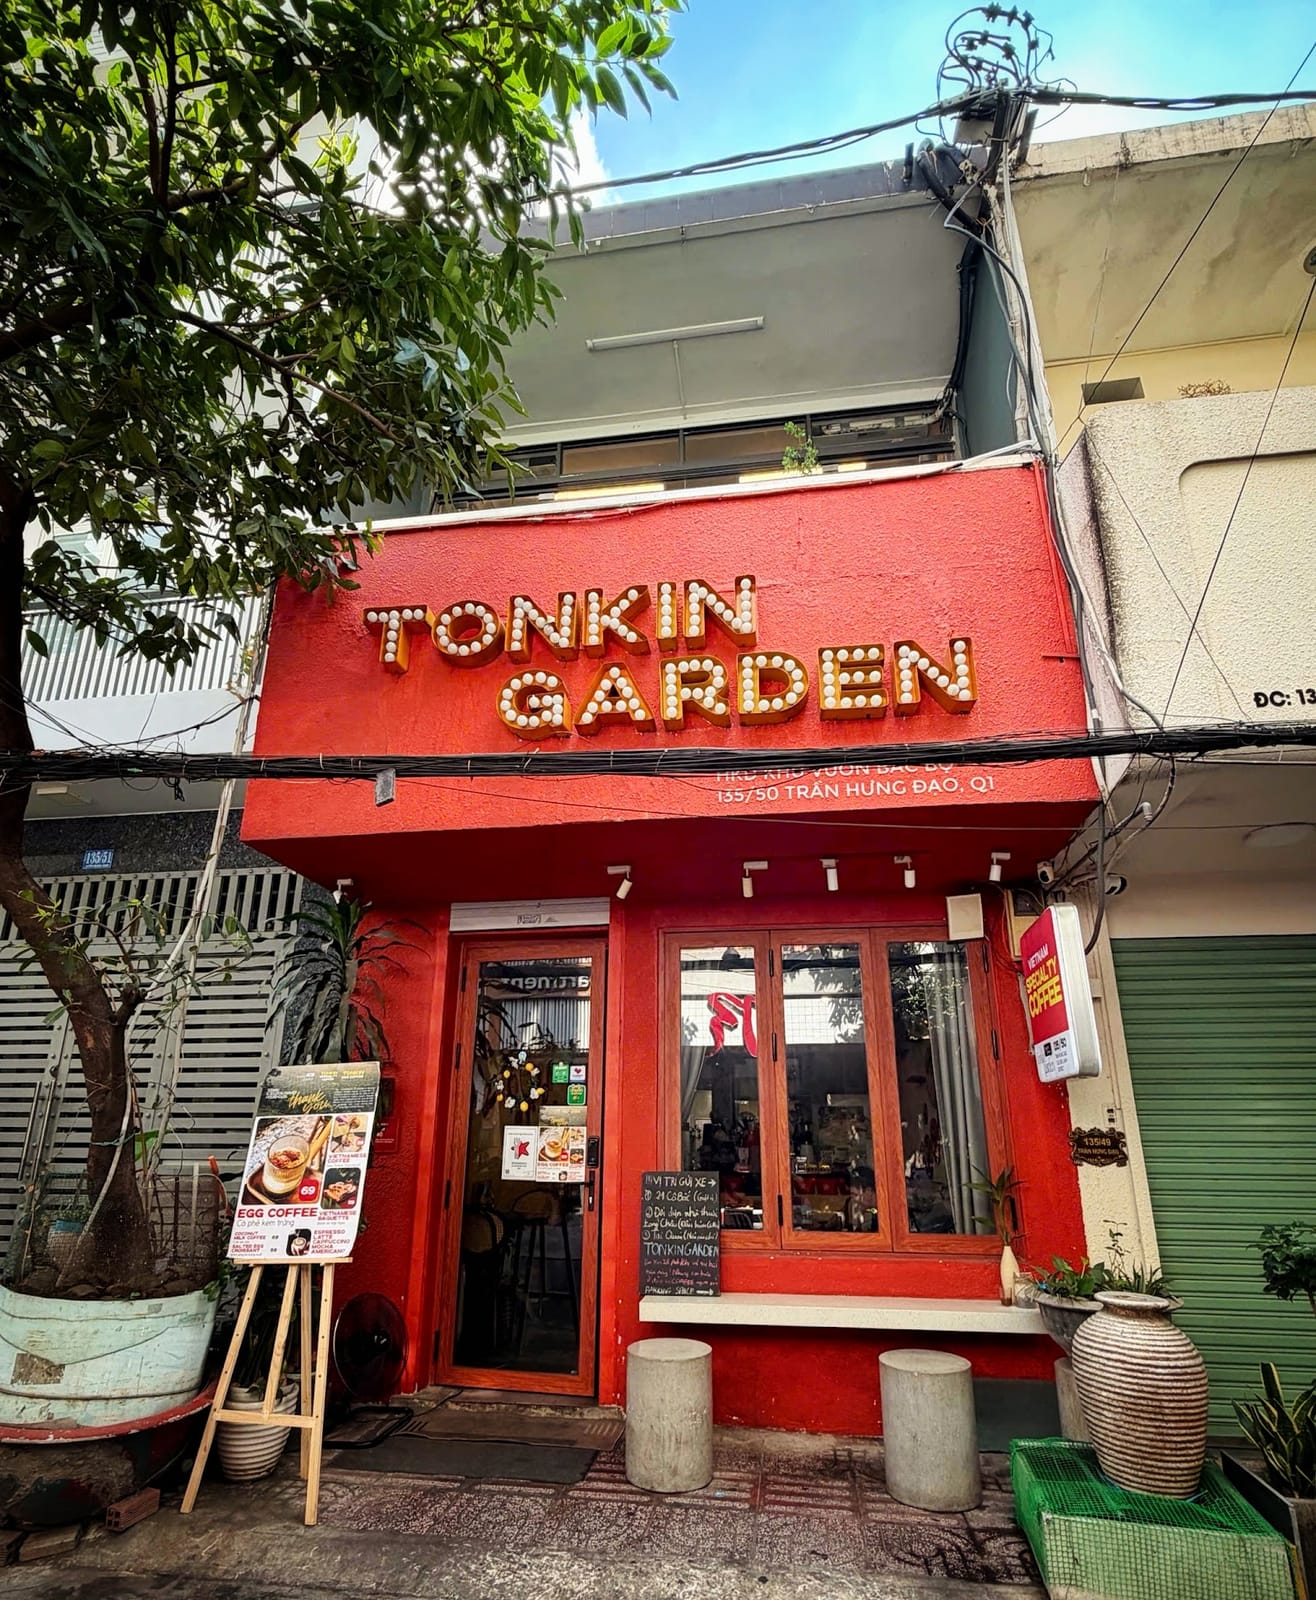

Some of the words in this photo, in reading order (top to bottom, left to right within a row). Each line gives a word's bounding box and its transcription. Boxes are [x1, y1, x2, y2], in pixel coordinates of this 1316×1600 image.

[363, 575, 757, 674] TONKIN
[497, 637, 978, 740] GARDEN
[1252, 691, 1292, 708] ĐC:
[718, 785, 779, 804] 135/50
[846, 780, 907, 796] HƯNG
[912, 777, 964, 796] ĐẠO,
[970, 776, 994, 793] Q1
[1028, 943, 1048, 970] VIETNAM
[1025, 955, 1058, 994] SPECIALTY
[1028, 974, 1062, 1018] COFFEE
[300, 1186, 316, 1195] 69
[238, 1208, 264, 1218] EGG
[268, 1208, 318, 1218] COFFEE
